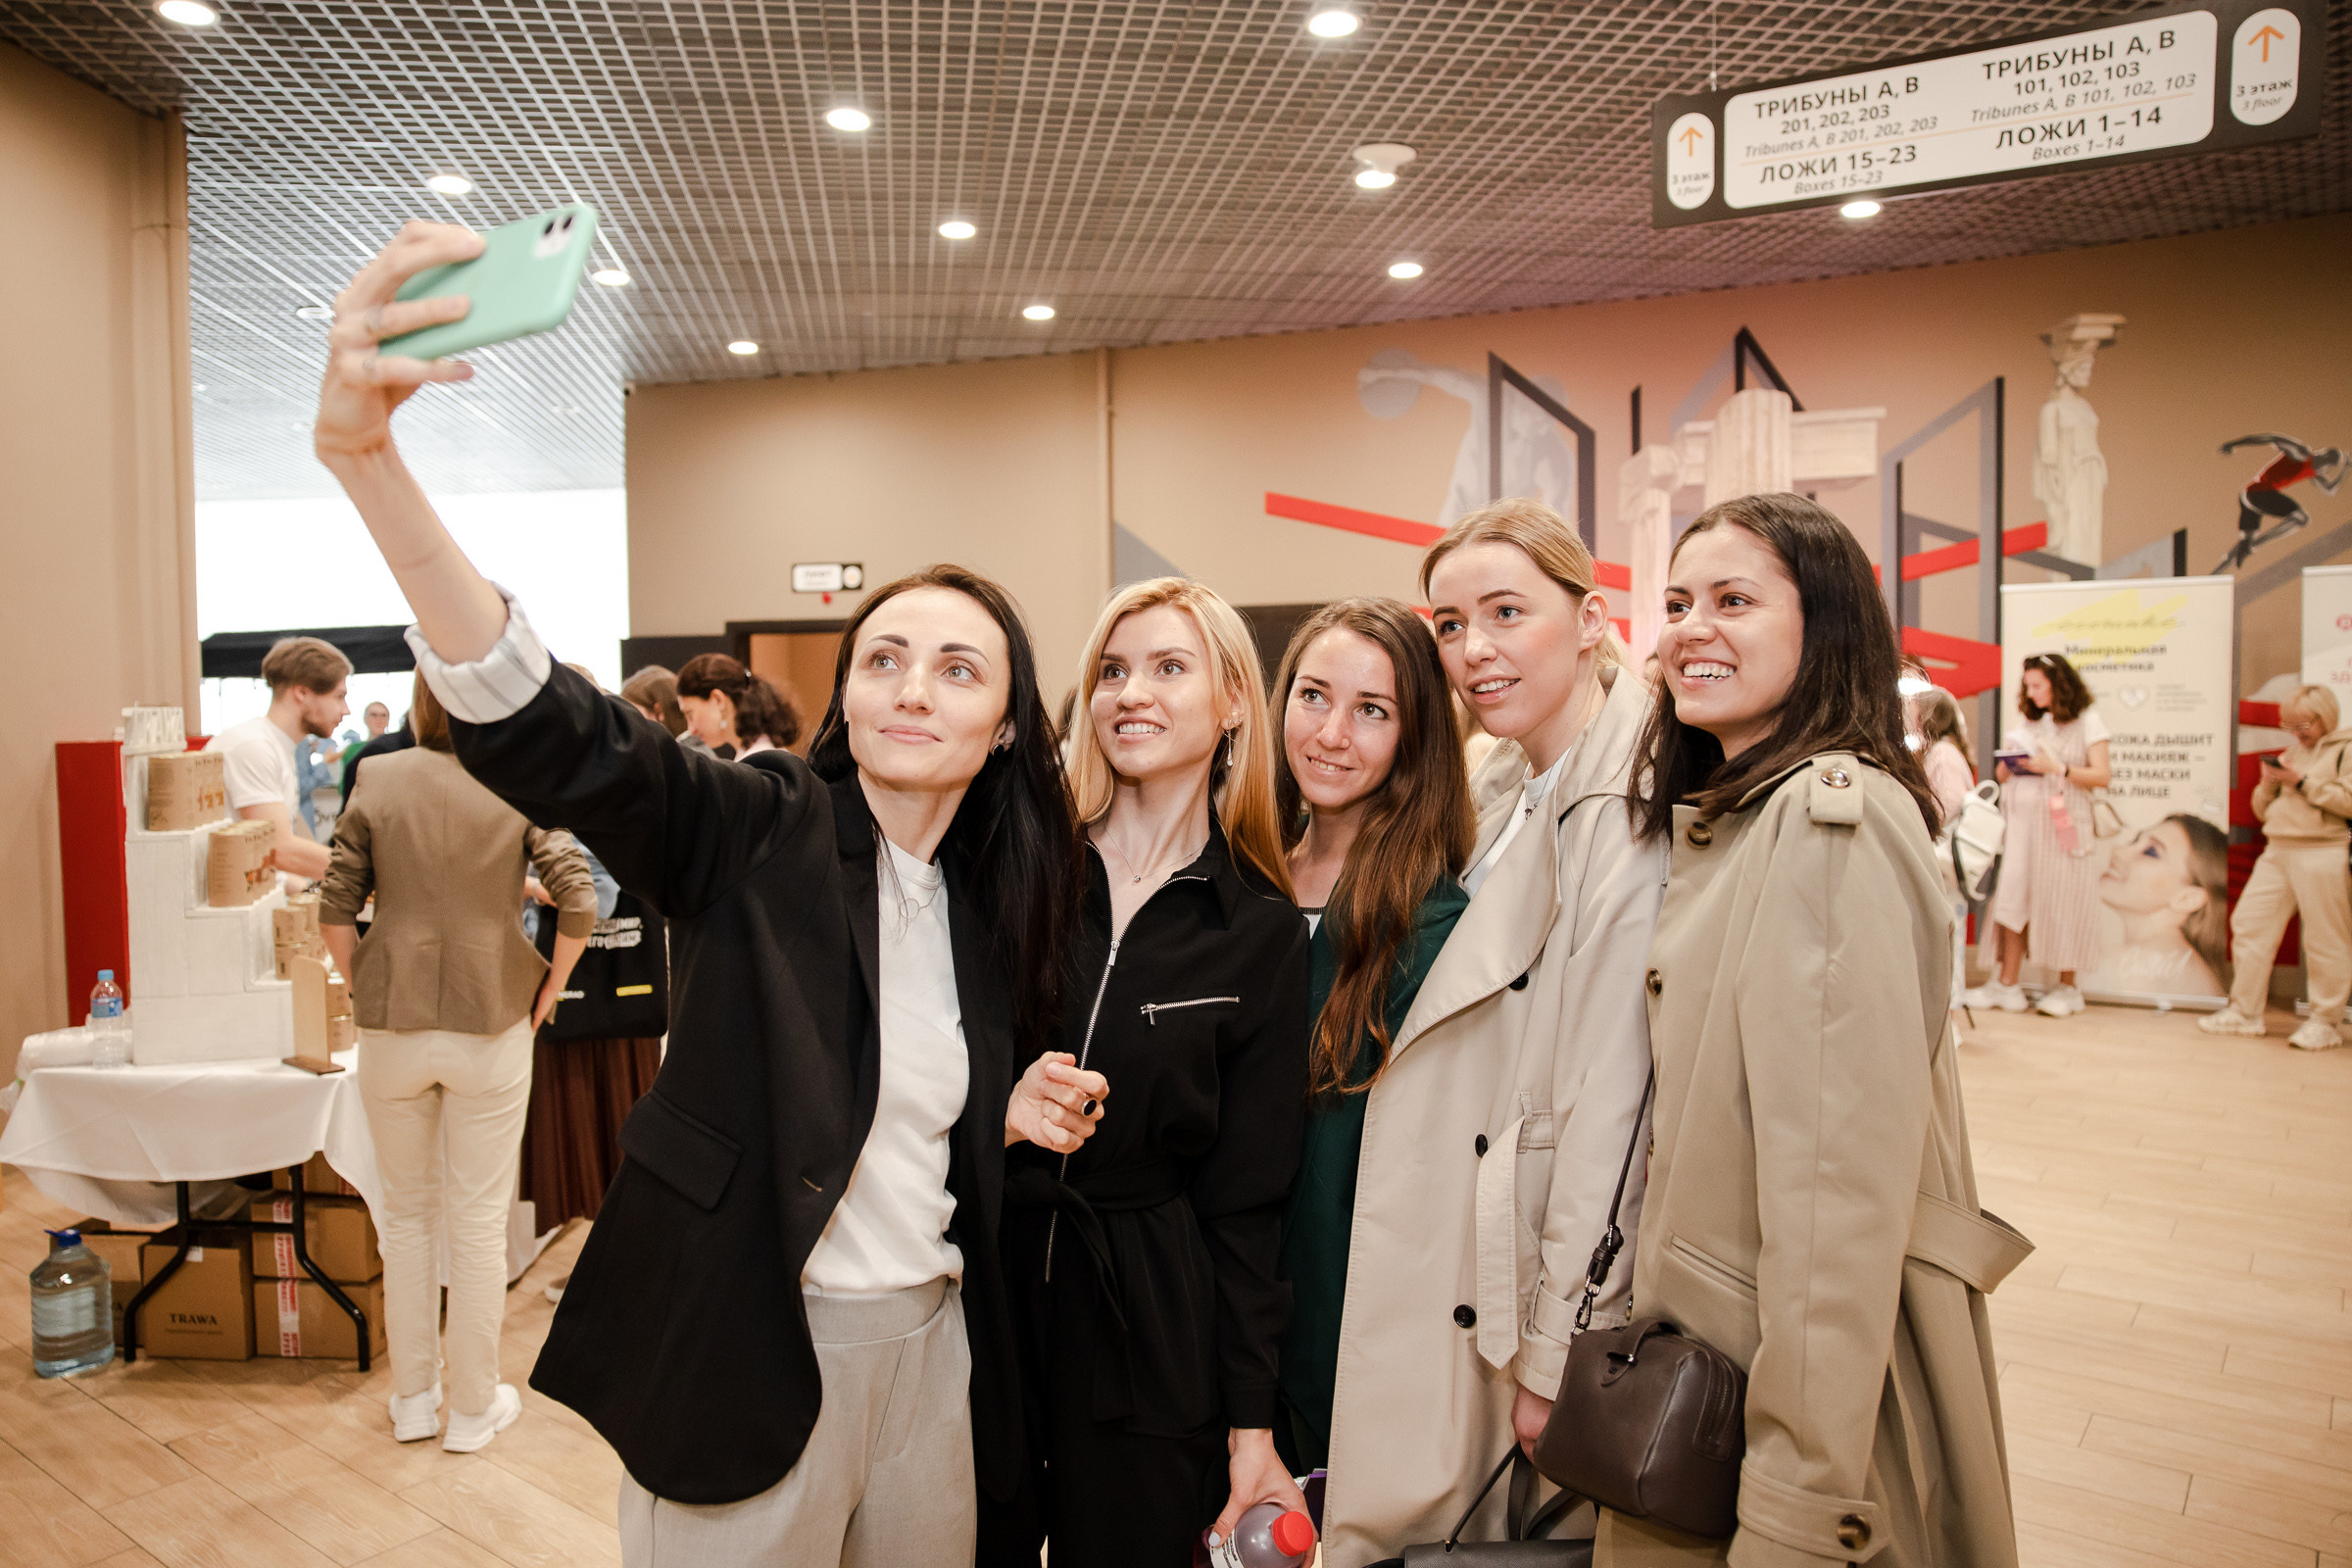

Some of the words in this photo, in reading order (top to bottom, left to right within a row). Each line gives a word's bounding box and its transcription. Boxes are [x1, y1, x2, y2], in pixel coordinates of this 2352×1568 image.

[1983, 41, 2114, 79] ТРИБУНЫ
[2014, 78, 2052, 95] 101,
[2060, 70, 2098, 88] 102,
[2106, 62, 2140, 80] 103
[2237, 85, 2244, 97] 3
[2251, 78, 2293, 96] этаж
[1755, 85, 1867, 119] ТРИБУНЫ
[1971, 95, 2039, 122] Tribunes
[2083, 88, 2114, 106] 101,
[2124, 81, 2156, 100] 102,
[2166, 74, 2196, 90] 103
[2243, 100, 2250, 111] 3
[2251, 95, 2282, 111] floor
[1781, 118, 1814, 135] 201,
[1820, 111, 1854, 128] 202,
[1860, 105, 1890, 121] 203
[1744, 139, 1804, 159] Tribunes
[1838, 129, 1869, 143] 201,
[1875, 122, 1904, 139] 202,
[1910, 116, 1938, 133] 203
[1996, 119, 2086, 149] ЛОЖИ
[2033, 143, 2080, 160] Boxes
[1672, 172, 1679, 184] 3
[1681, 172, 1711, 184] этаж
[1760, 157, 1838, 184] ЛОЖИ
[1684, 184, 1705, 197] floor
[1793, 178, 1836, 195] Boxes
[2154, 733, 2214, 747] ДЫШИТ
[2137, 768, 2190, 780] МАСКИ
[2131, 785, 2172, 798] ЛИЦЕ
[170, 1313, 218, 1326] TRAWA
